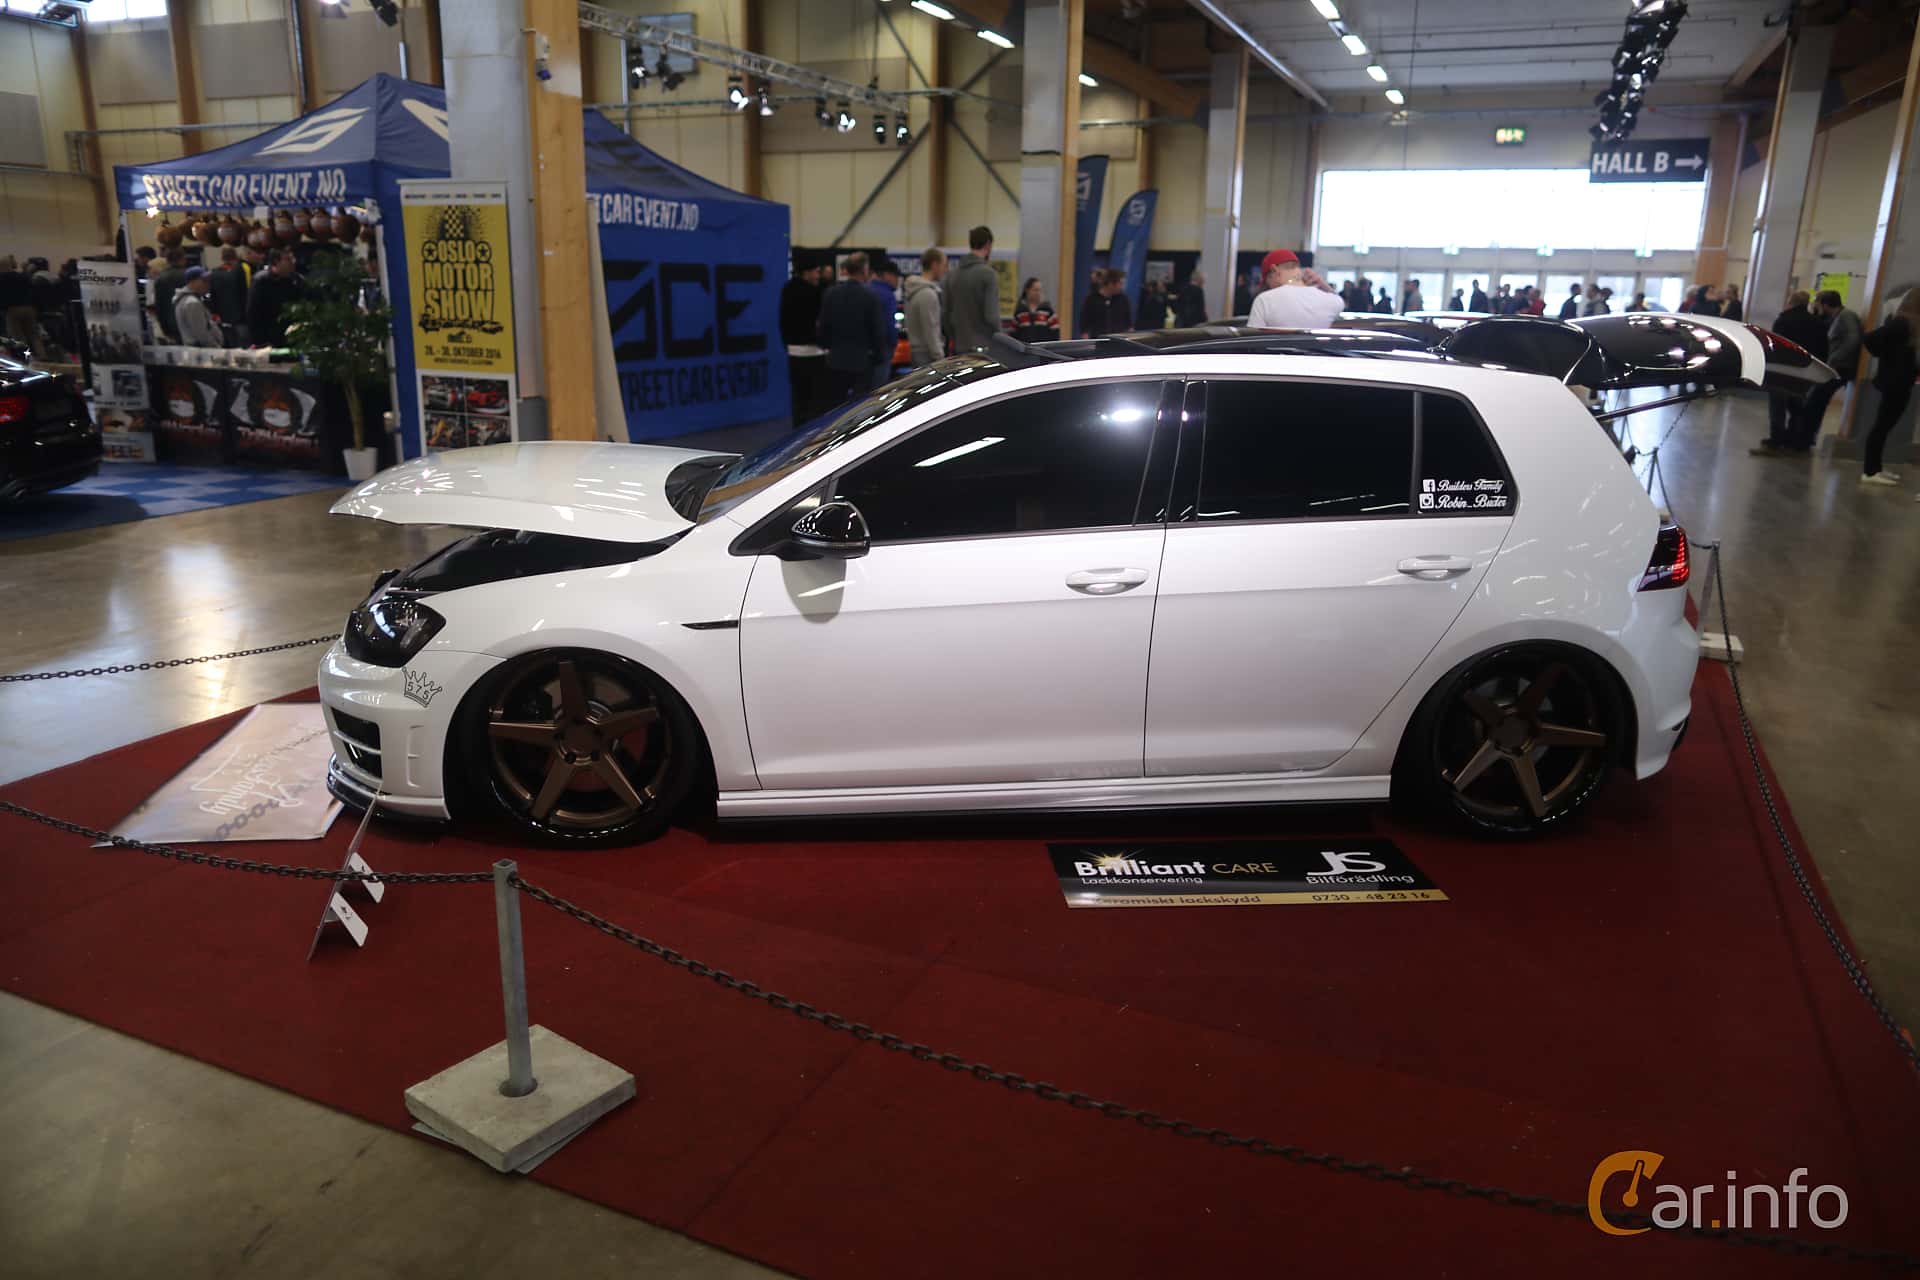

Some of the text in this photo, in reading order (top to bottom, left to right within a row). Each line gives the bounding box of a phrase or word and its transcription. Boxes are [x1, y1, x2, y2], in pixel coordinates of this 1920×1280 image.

[1591, 151, 1669, 174] HALL B
[438, 240, 476, 261] OSLO
[424, 261, 494, 291] MOTOR
[425, 288, 494, 321] SHOW
[1437, 478, 1505, 493] Builders Family
[407, 681, 430, 700] 575
[1073, 859, 1280, 877] Brilliant CARE
[1306, 851, 1387, 876] JS
[1081, 876, 1204, 885] Lackkonservering
[1306, 875, 1415, 885] Bilförädling
[1179, 895, 1262, 905] lackskydd
[1312, 893, 1350, 902] 0730
[1387, 892, 1407, 900] 23
